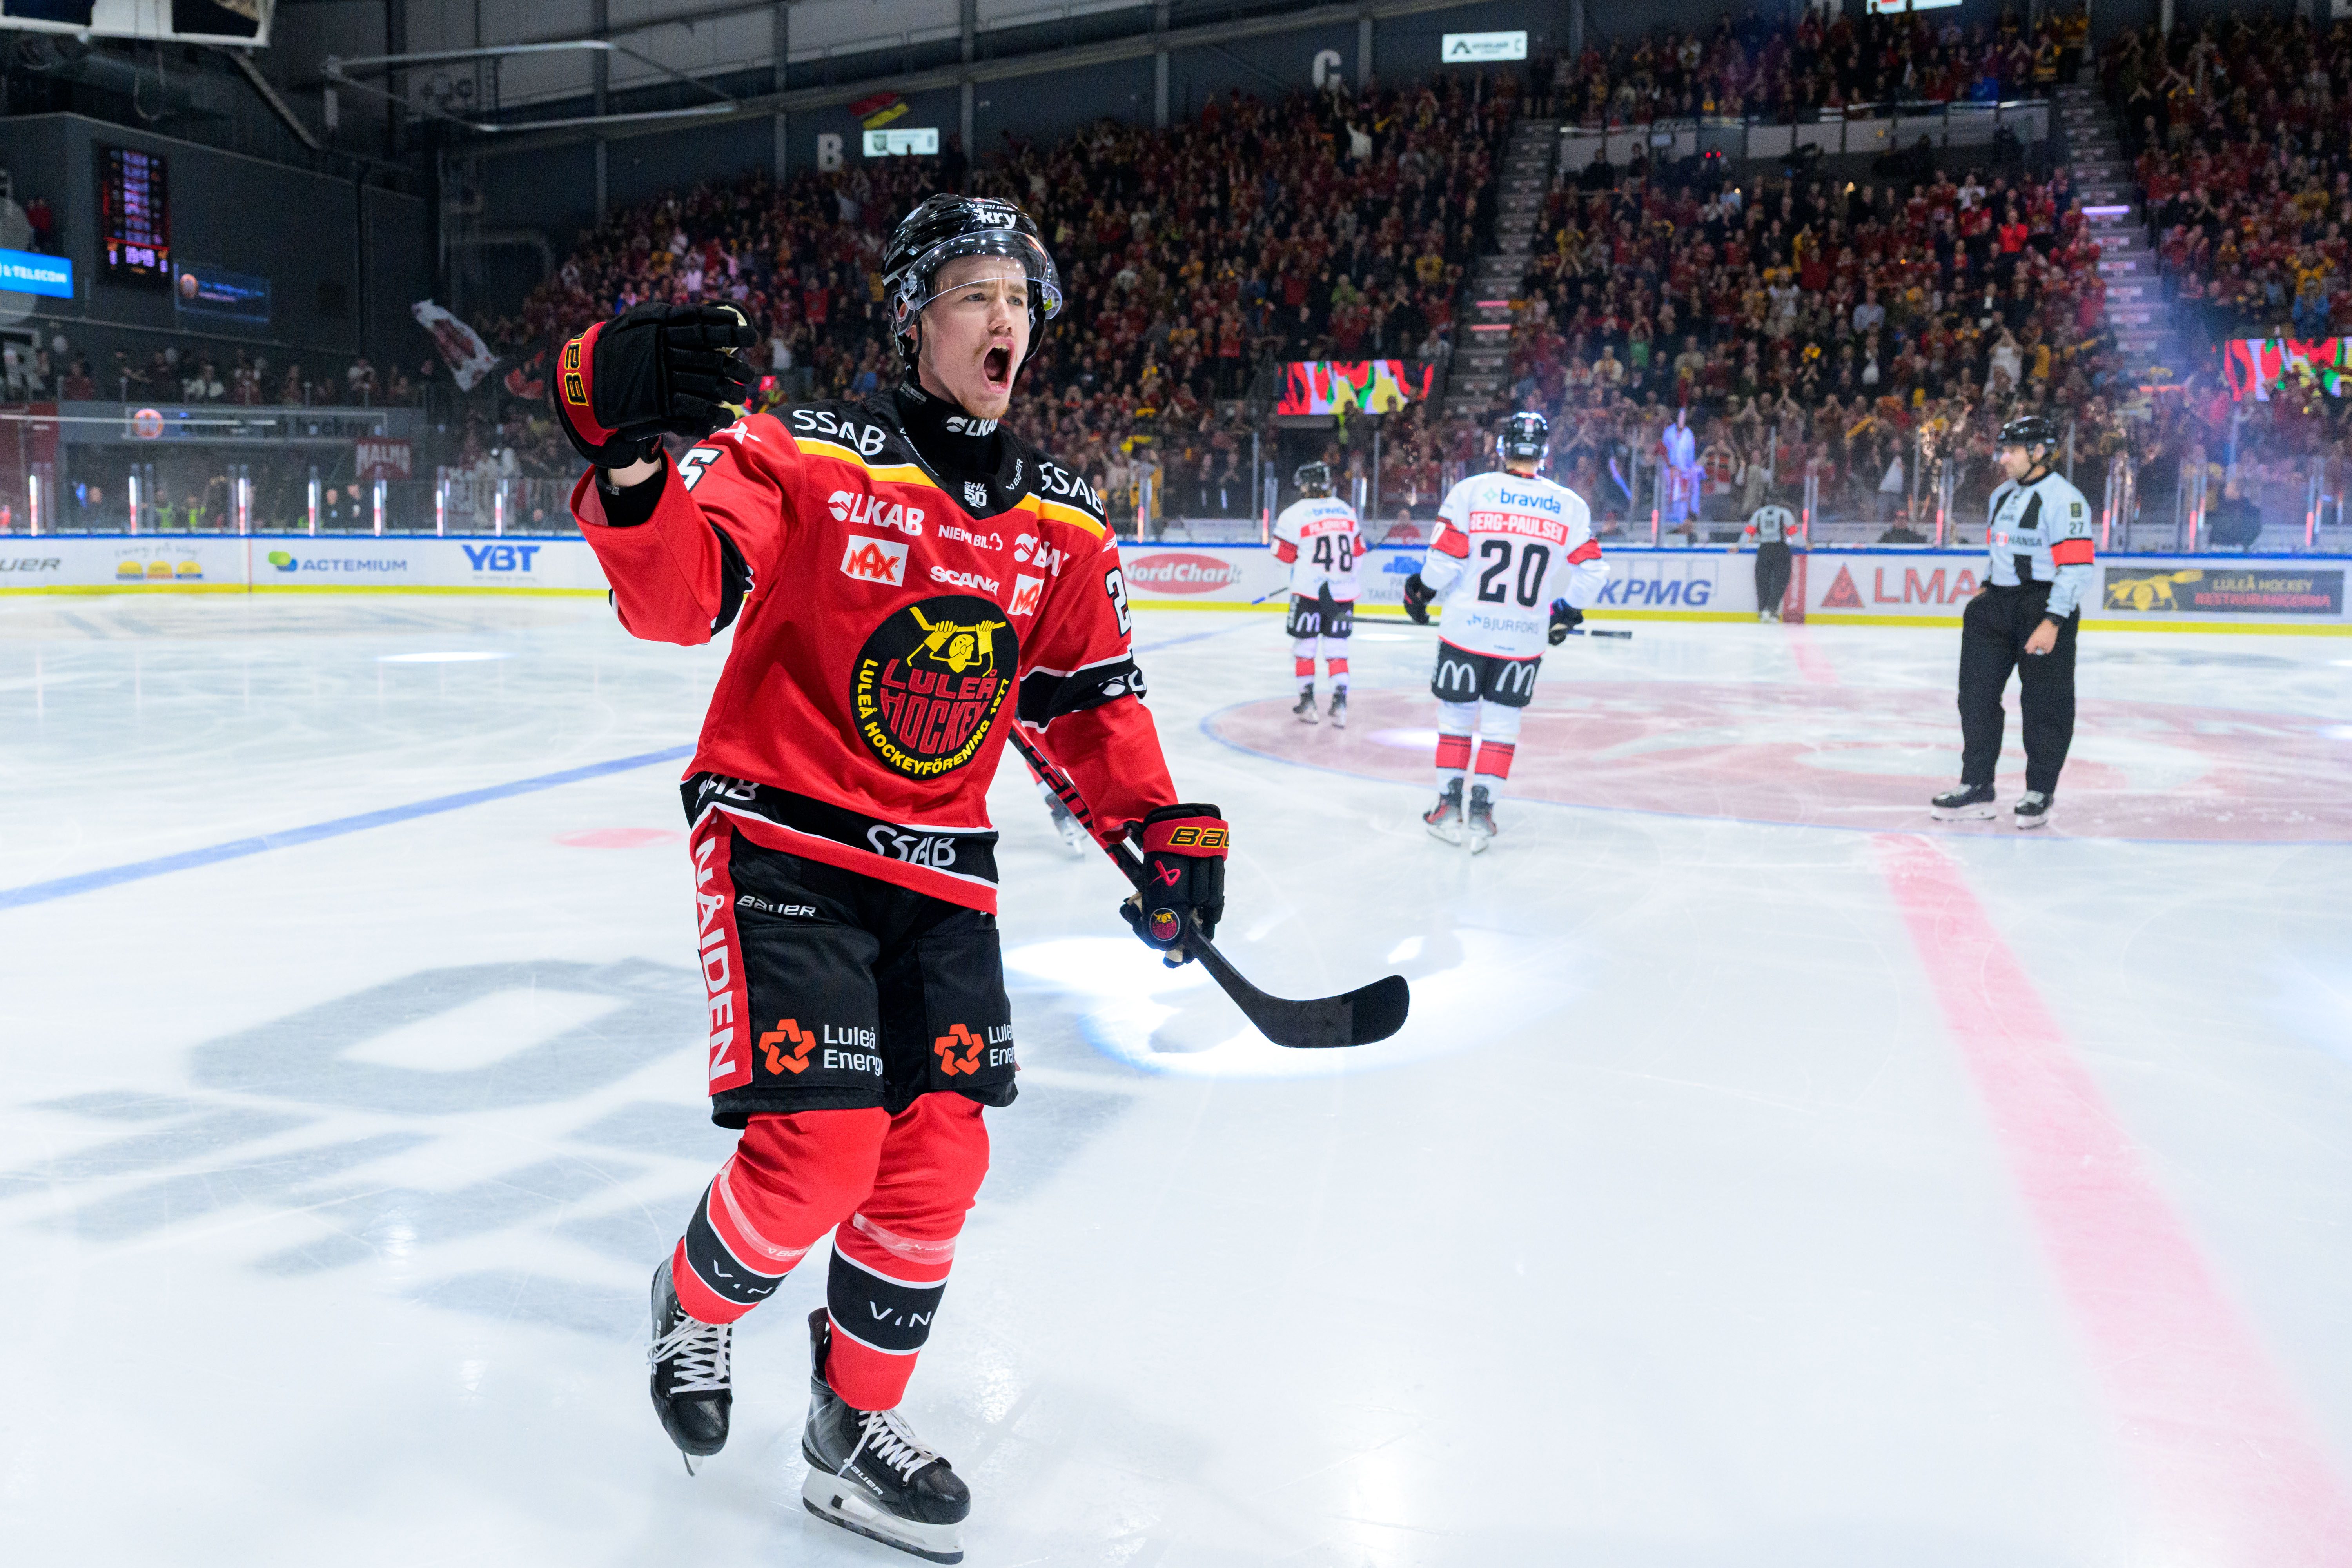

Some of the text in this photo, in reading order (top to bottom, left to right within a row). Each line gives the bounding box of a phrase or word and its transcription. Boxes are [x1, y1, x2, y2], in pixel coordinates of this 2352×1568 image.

[818, 132, 842, 172] B
[978, 208, 1016, 230] kry
[12, 265, 67, 283] TELECOM
[793, 410, 886, 456] SSAB
[1039, 462, 1105, 515] SSAB
[1500, 487, 1561, 514] bravida
[849, 493, 925, 536] LKAB
[2069, 521, 2084, 534] 27
[302, 559, 407, 572] ACTEMIUM
[463, 545, 541, 572] YBT
[846, 542, 900, 582] MAX
[1312, 534, 1353, 572] 48
[1477, 540, 1550, 608] 20
[1597, 579, 1712, 606] KPMG
[2213, 574, 2313, 593] LULEÅ HOCKEY
[881, 658, 998, 700] LULEÅ
[857, 659, 1010, 775] LULEÅ HOCKEYFÖRENING 1977
[880, 687, 988, 754] HOCKEY
[867, 824, 956, 866] SSAB
[696, 837, 736, 1081] NÅIDEN
[824, 1024, 875, 1049] Luleå
[988, 1024, 1013, 1044] Lule
